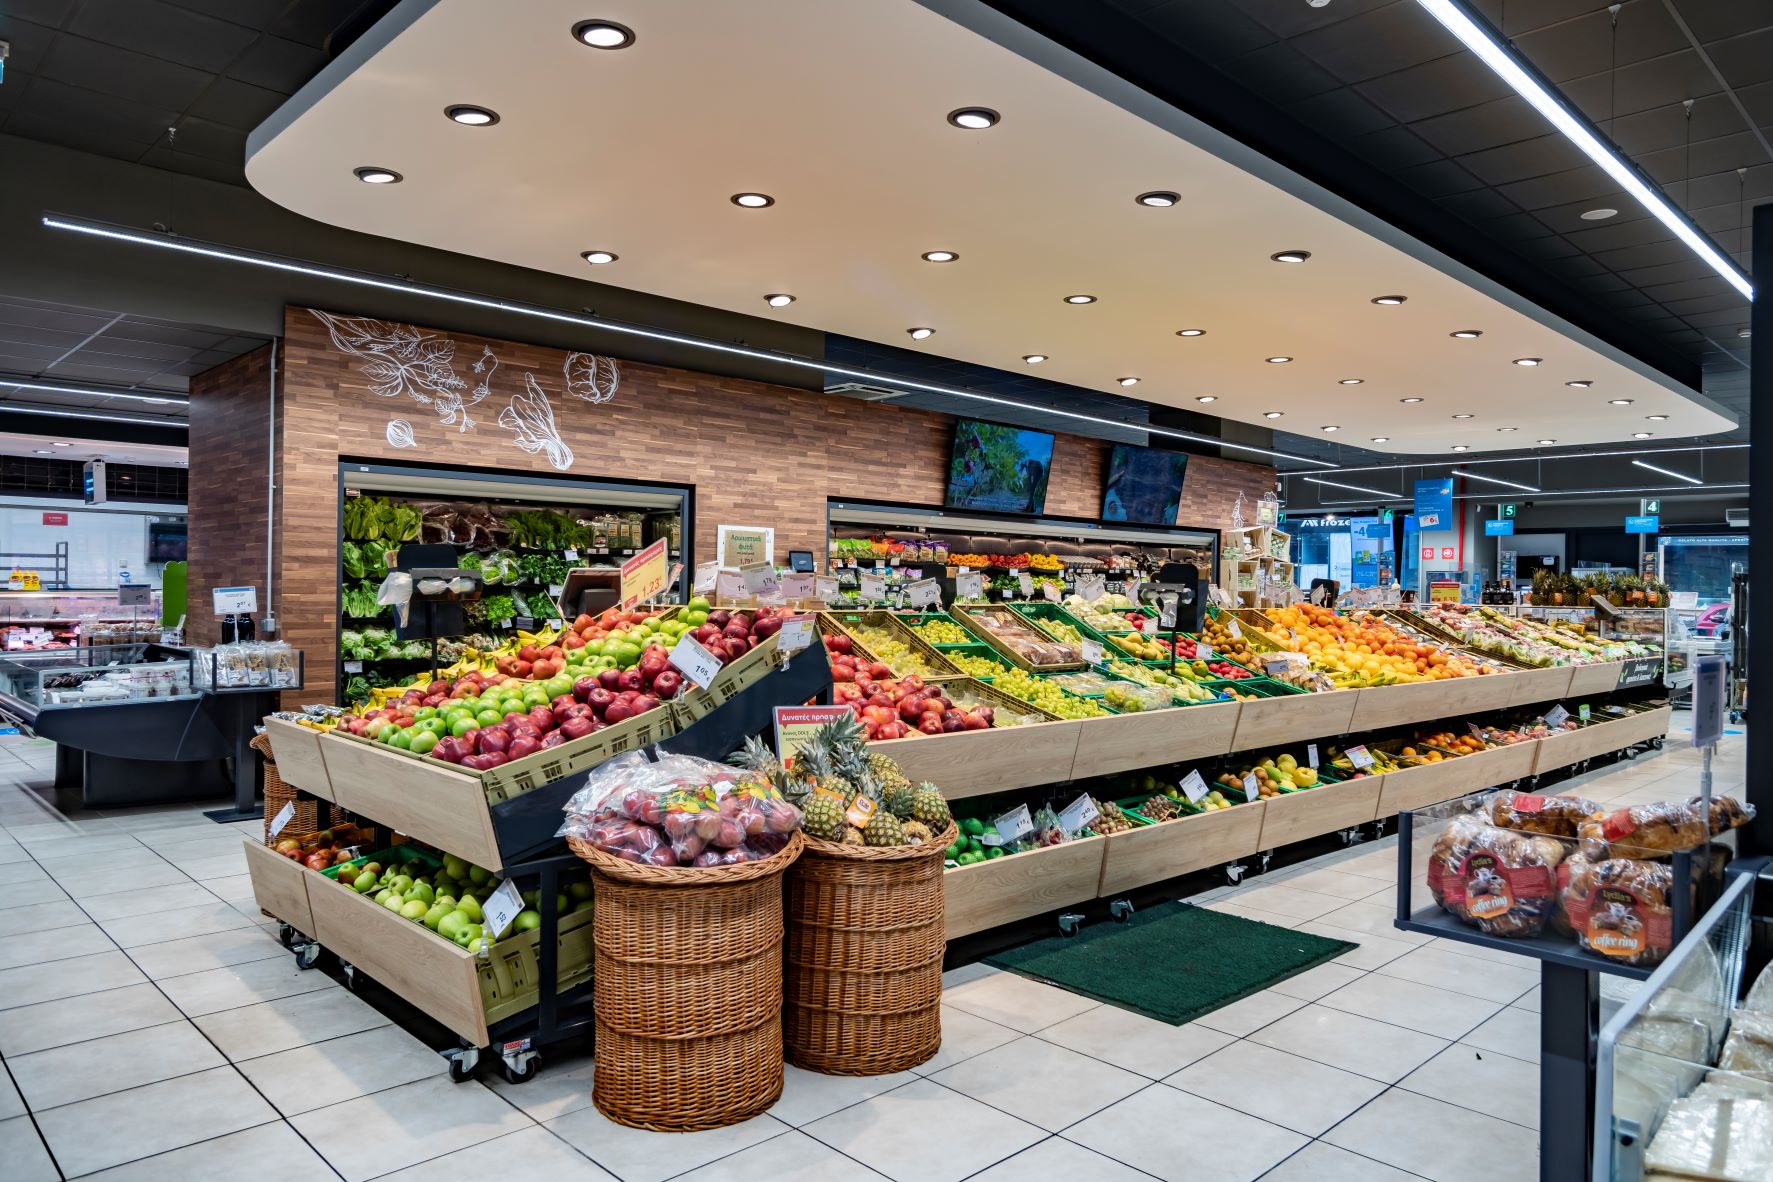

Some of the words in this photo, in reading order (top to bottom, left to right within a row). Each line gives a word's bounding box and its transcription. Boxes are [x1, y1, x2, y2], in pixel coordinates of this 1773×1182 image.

[1505, 505, 1514, 516] 5
[1647, 501, 1657, 512] 4
[1279, 513, 1285, 522] 7
[1384, 509, 1392, 519] 6
[781, 713, 810, 722] Δυνατές
[1602, 889, 1632, 903] Lydia's
[1471, 898, 1491, 914] coffee
[1491, 895, 1508, 909] ring
[1593, 933, 1618, 947] coffee
[1618, 935, 1638, 949] ring
